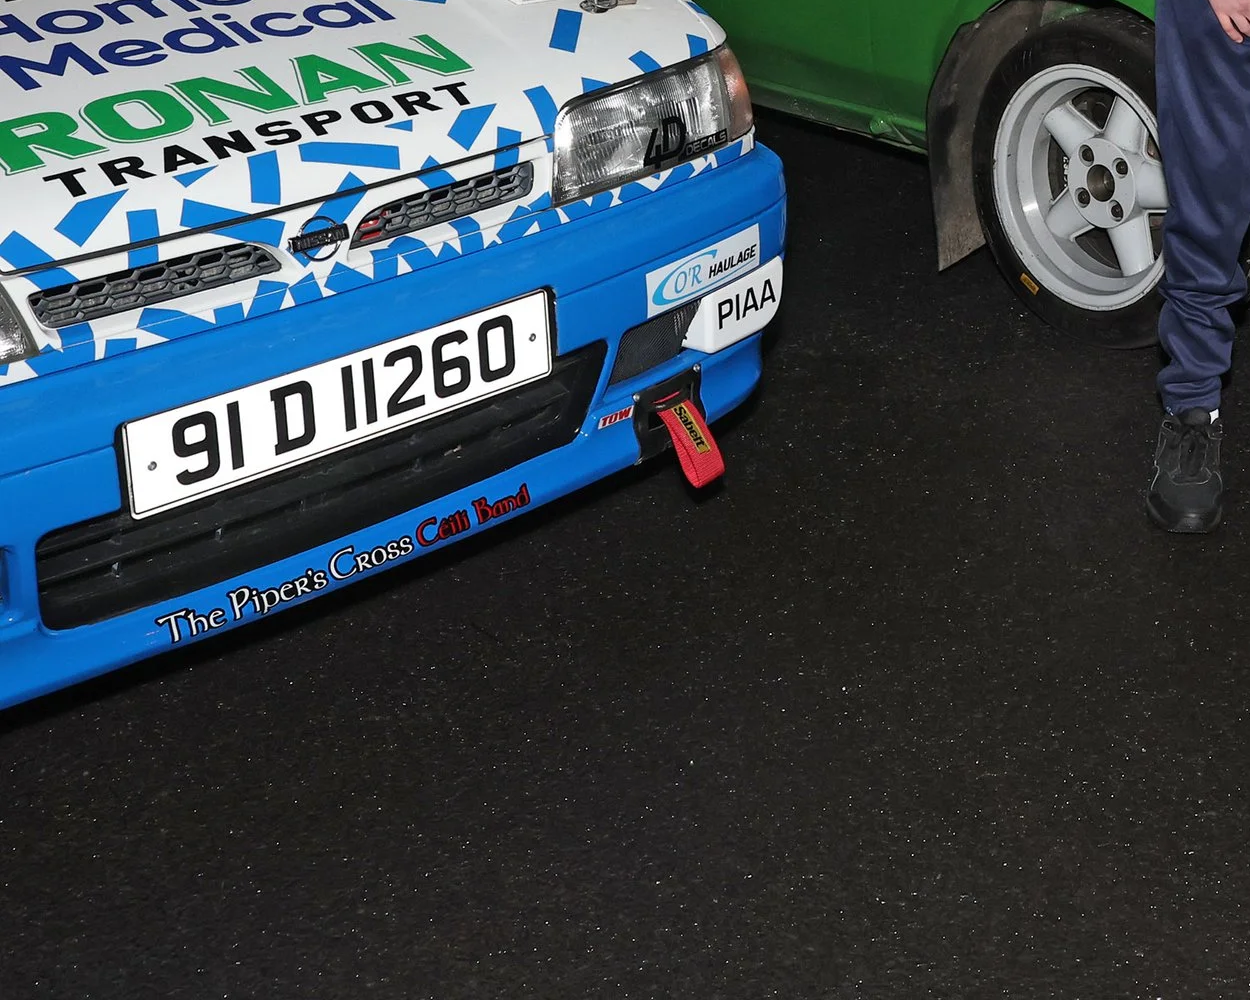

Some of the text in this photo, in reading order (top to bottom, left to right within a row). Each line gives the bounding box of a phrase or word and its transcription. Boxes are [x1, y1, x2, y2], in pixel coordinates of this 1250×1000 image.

[0, 34, 474, 175] RONAN
[43, 82, 471, 198] TRANSPORT
[643, 117, 687, 170] 4D
[686, 131, 727, 156] DECALS
[708, 244, 757, 279] HAULAGE
[717, 278, 777, 330] PIAA
[172, 314, 516, 486] 91 D 11260
[601, 407, 633, 428] TOW
[673, 405, 706, 449] Sabelt
[158, 606, 226, 644] The
[471, 482, 531, 525] Band
